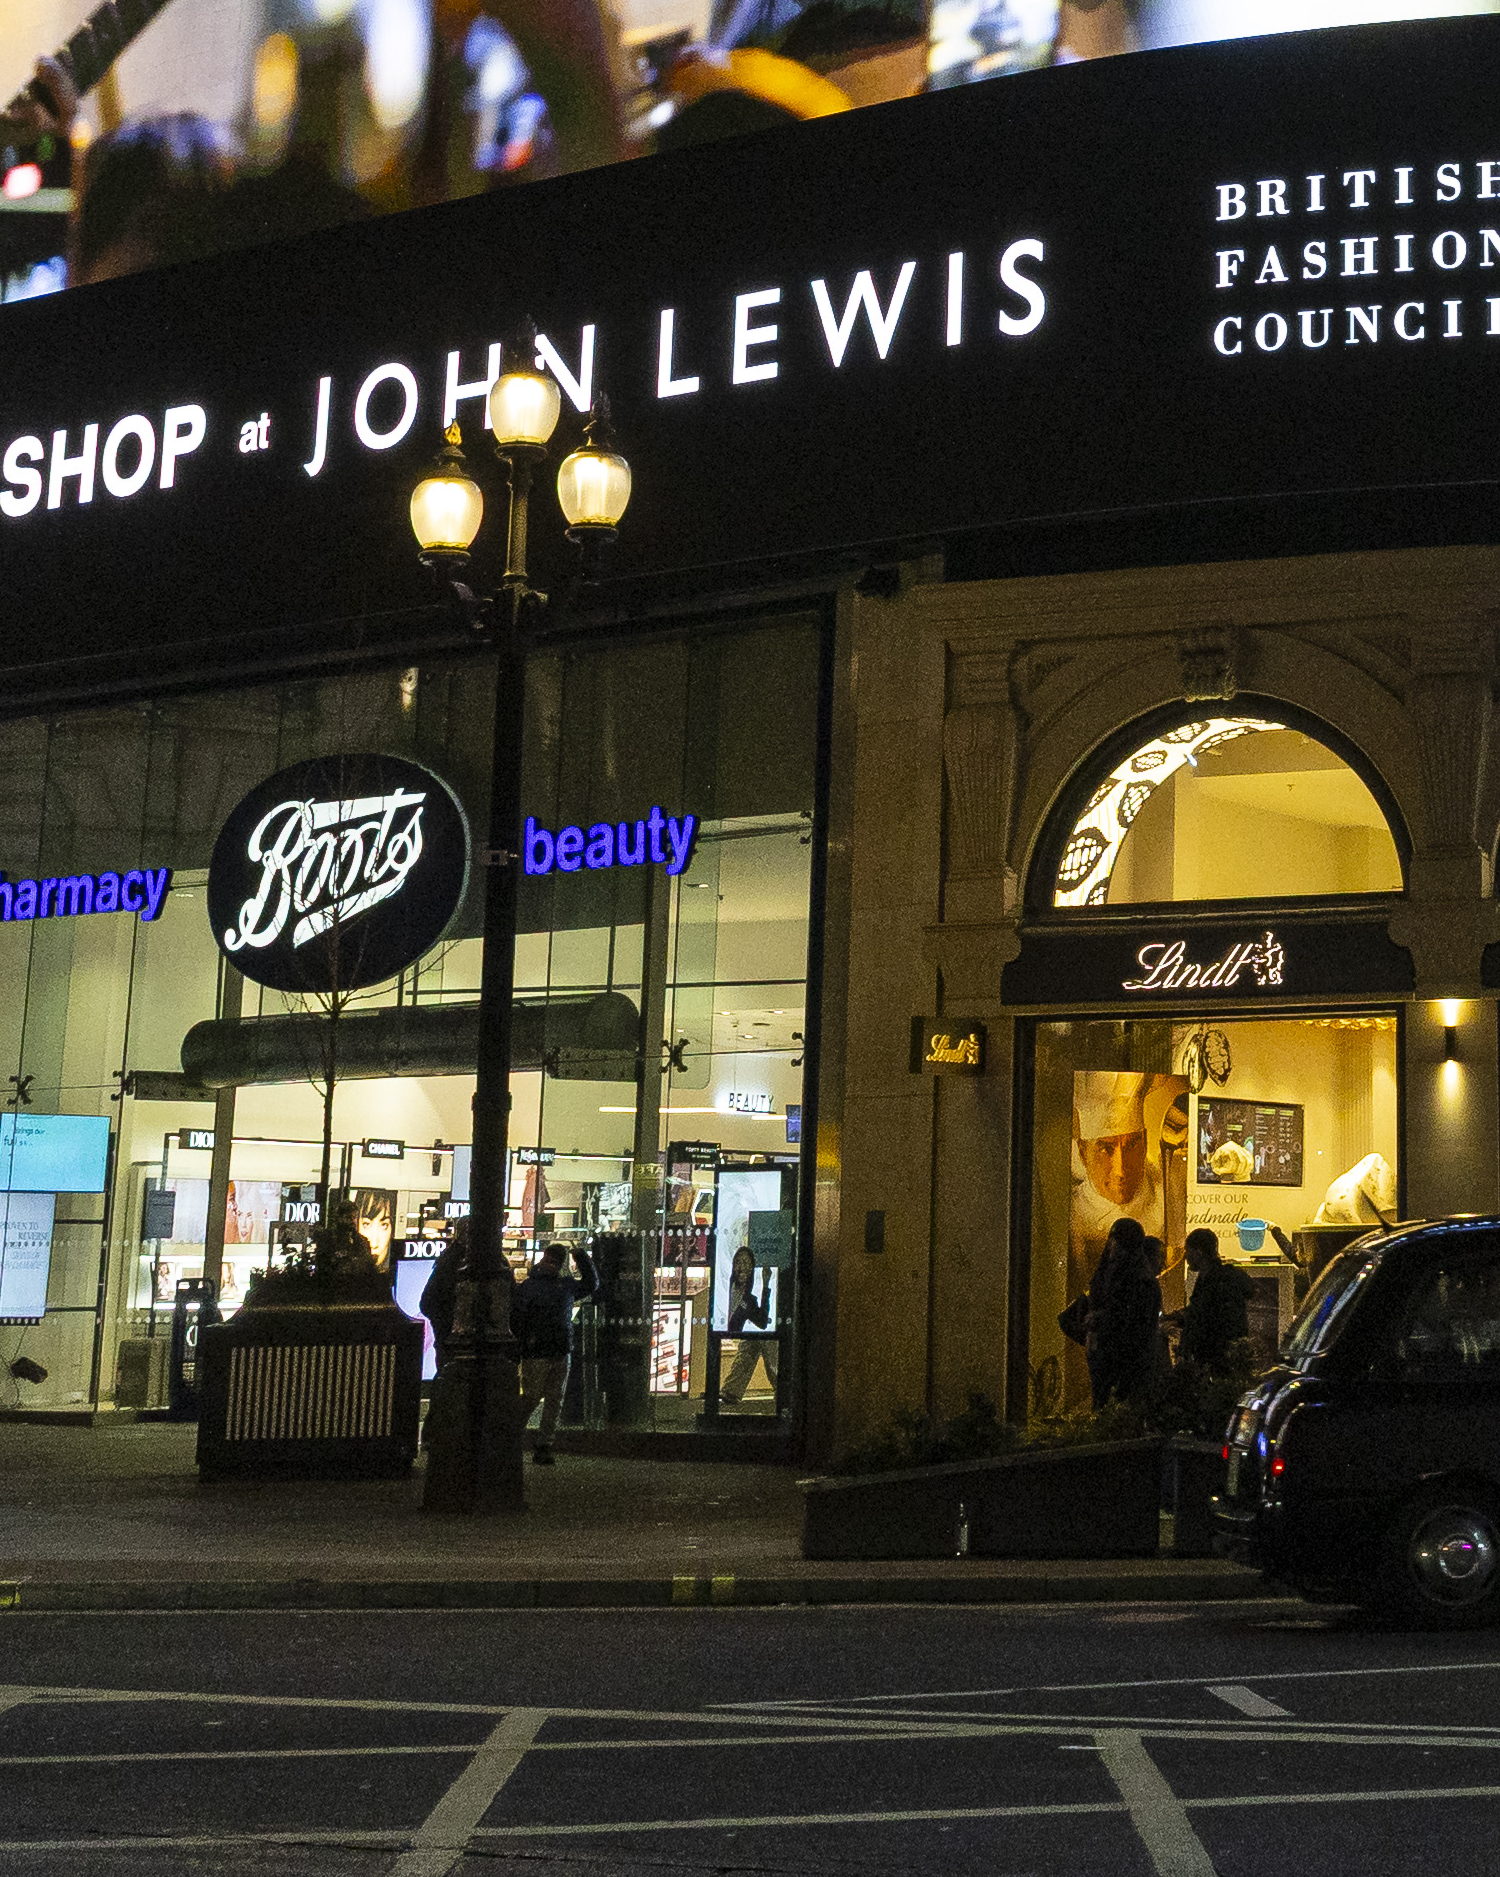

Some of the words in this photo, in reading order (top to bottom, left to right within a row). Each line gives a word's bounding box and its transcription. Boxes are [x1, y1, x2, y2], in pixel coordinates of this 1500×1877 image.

[238, 412, 272, 455] at
[303, 323, 597, 477] JOHN
[657, 238, 1046, 400] LEWIS
[523, 804, 698, 878] beauty
[223, 787, 428, 951] Boots
[1122, 940, 1256, 991] Lindt
[925, 1033, 967, 1063] Lindt
[728, 1092, 775, 1112] BEAUTY
[189, 1131, 215, 1149] DIO
[368, 1142, 401, 1156] CHANEL
[1186, 1193, 1221, 1205] COVER
[1223, 1193, 1249, 1205] OUR
[284, 1202, 321, 1224] DIOR
[443, 1201, 471, 1219] DIOR
[1185, 1207, 1249, 1224] ndmade
[17, 1231, 49, 1240] REVERSE
[29, 1221, 40, 1231] TO
